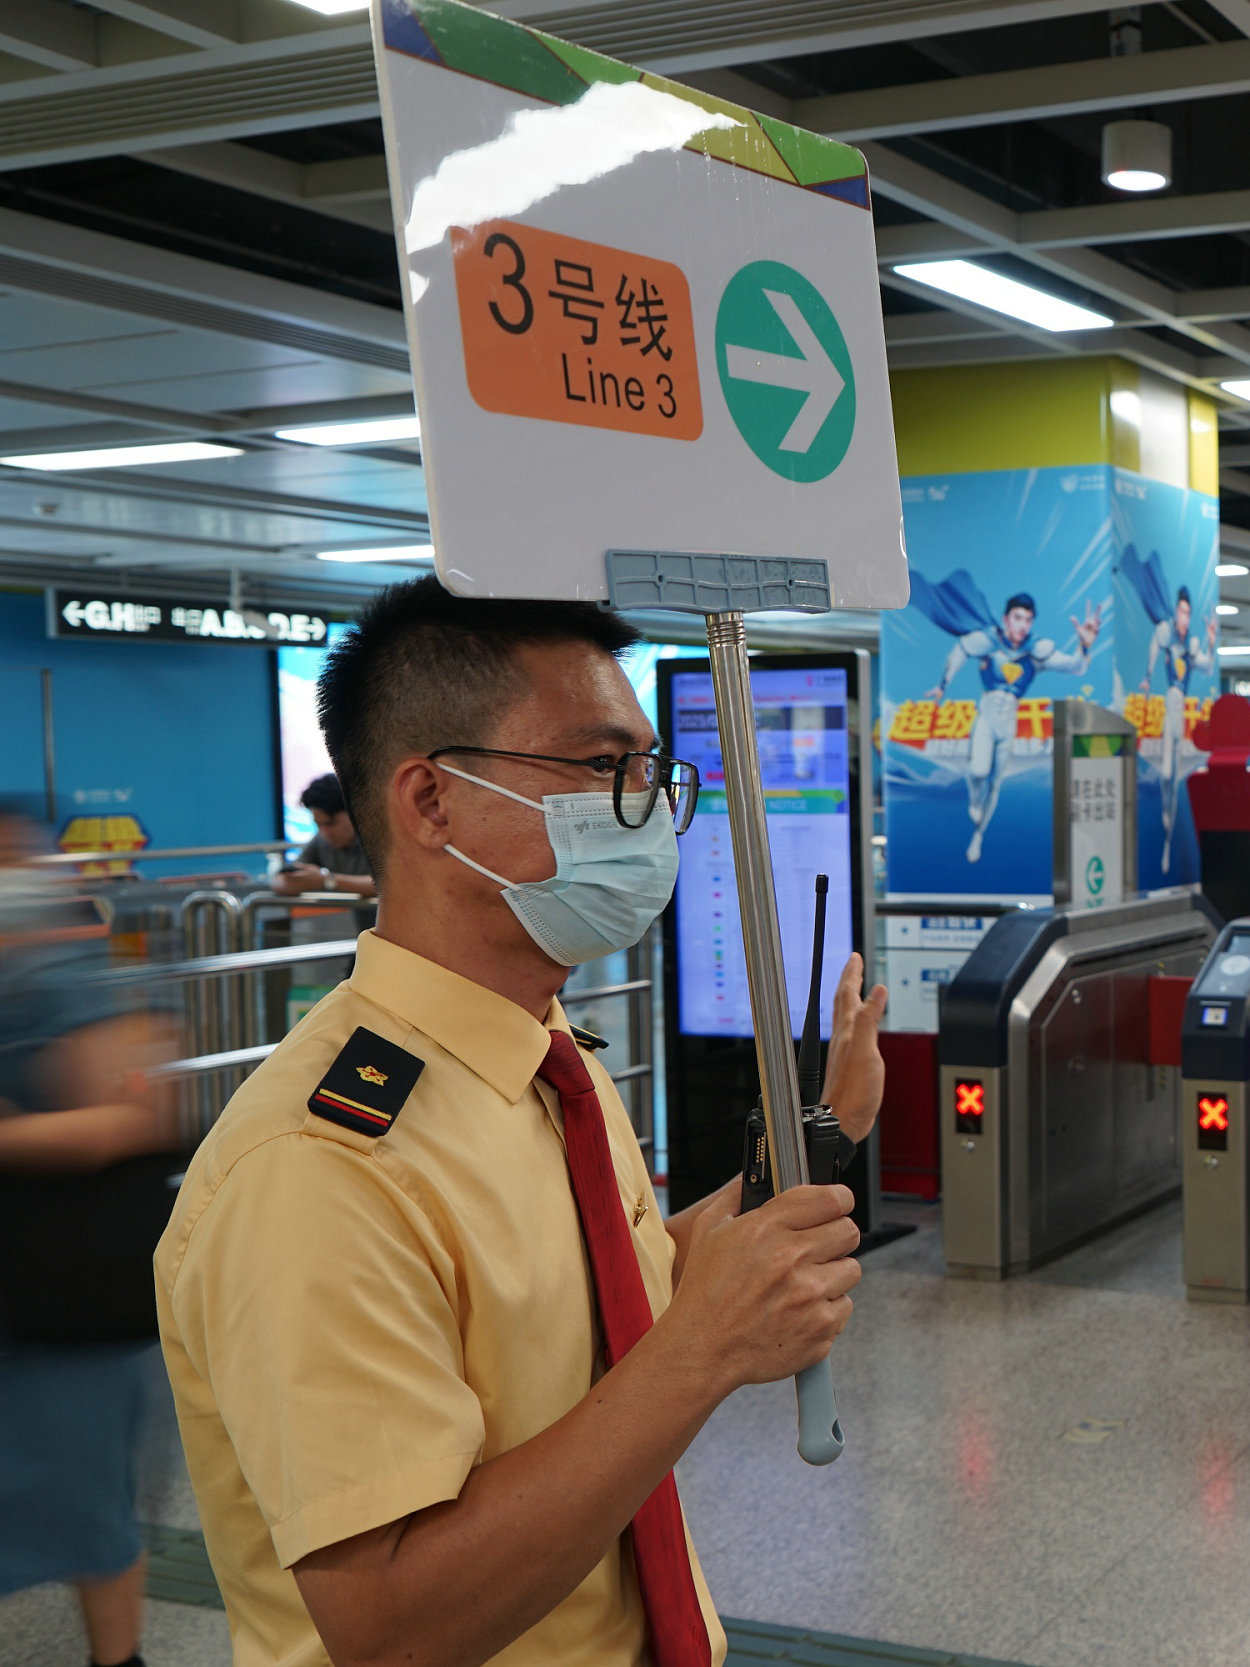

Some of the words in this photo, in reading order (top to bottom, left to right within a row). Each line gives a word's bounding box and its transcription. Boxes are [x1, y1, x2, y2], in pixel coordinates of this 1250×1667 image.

[482, 231, 673, 362] 3号线
[561, 352, 646, 412] Line
[656, 373, 677, 419] 3
